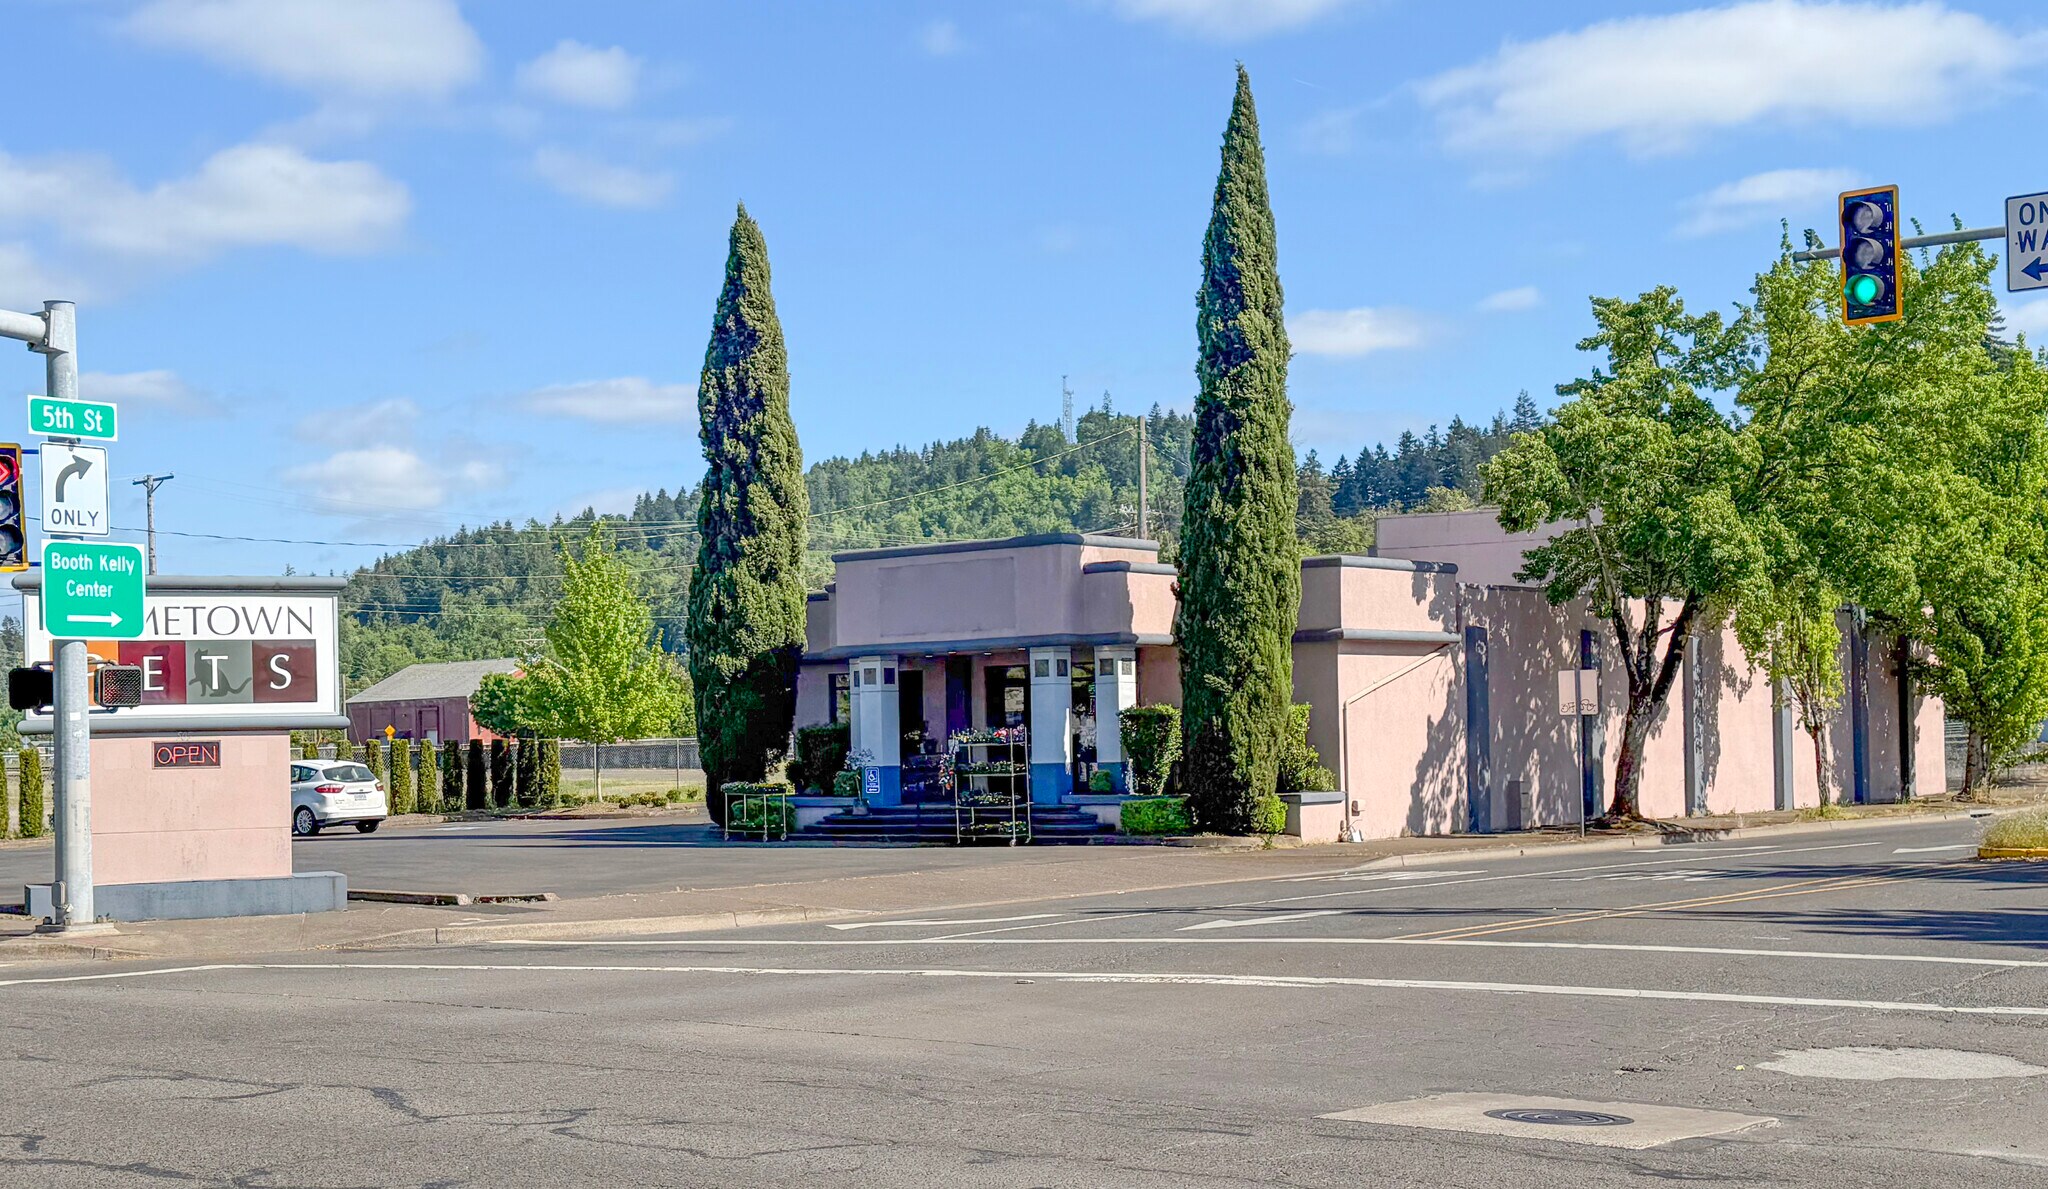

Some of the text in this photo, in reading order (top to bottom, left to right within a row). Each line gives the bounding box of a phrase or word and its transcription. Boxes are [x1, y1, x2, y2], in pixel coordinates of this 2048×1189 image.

[43, 405, 103, 433] 5th St
[51, 508, 99, 527] ONLY
[51, 552, 135, 576] Booth Kelly
[66, 579, 113, 598] Center
[156, 745, 217, 764] OPEN
